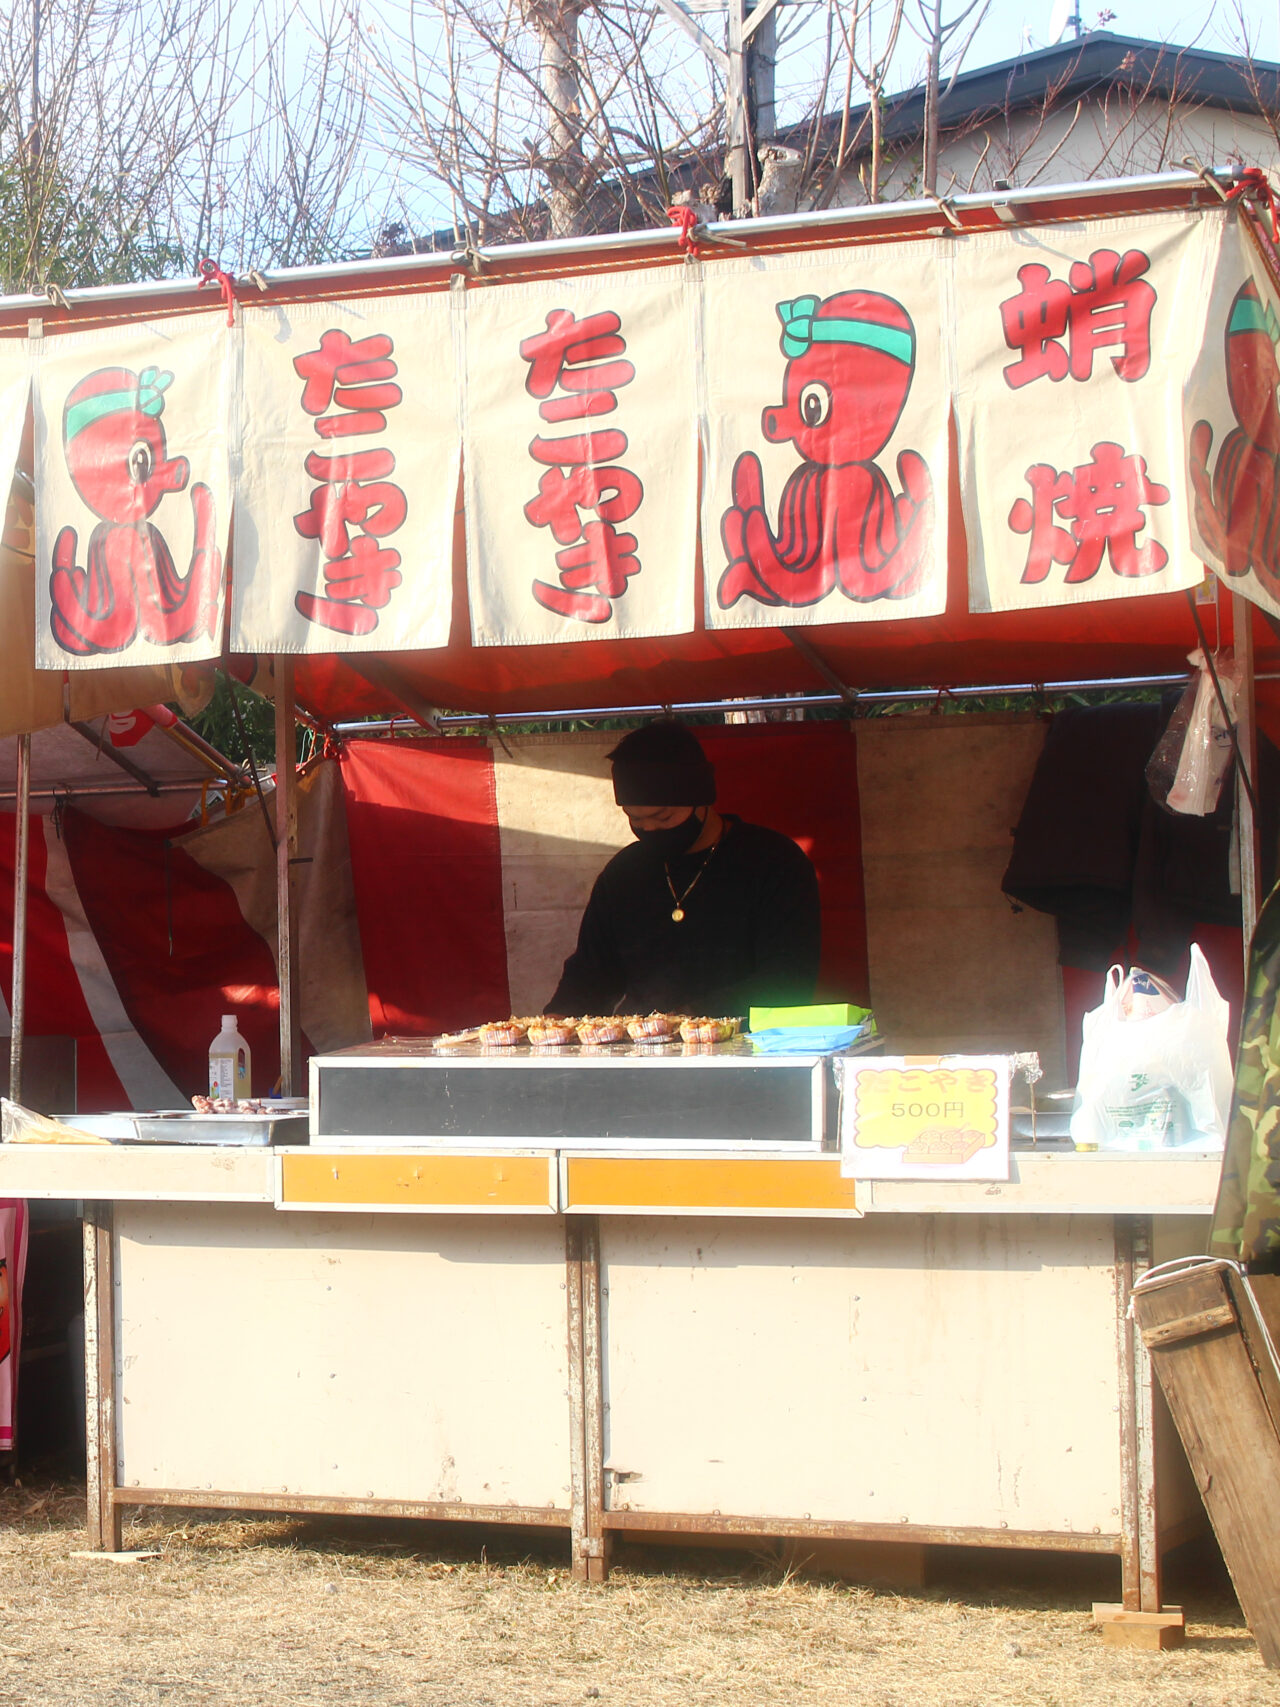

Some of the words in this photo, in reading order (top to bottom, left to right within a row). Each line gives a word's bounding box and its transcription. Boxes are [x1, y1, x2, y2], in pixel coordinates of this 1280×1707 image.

[293, 328, 408, 636] たこやき
[519, 308, 645, 625] たこやき
[999, 248, 1170, 587] 蛸焼
[861, 1073, 989, 1094] たこやき
[891, 1102, 964, 1118] 500円
